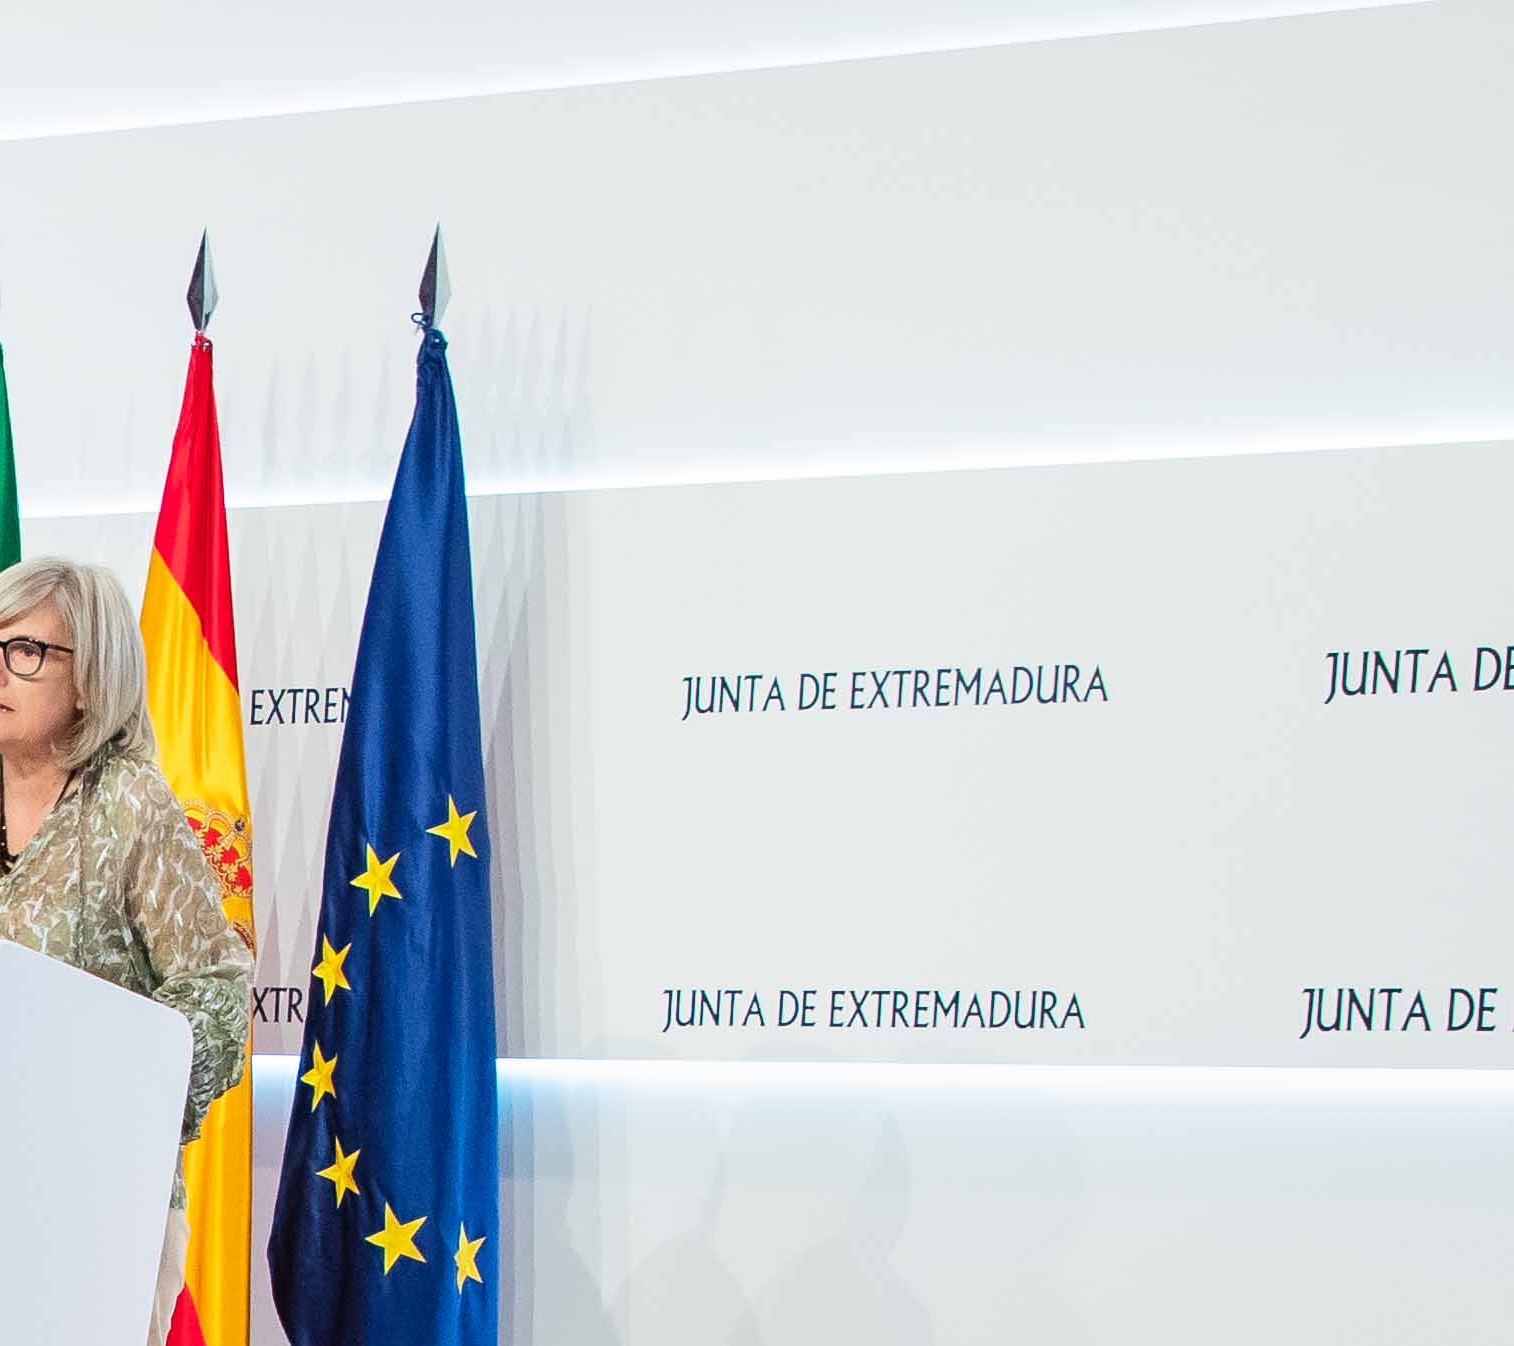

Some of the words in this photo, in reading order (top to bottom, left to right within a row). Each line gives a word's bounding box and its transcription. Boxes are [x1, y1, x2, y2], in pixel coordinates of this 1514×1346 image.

[681, 674, 786, 721] JUNTA
[798, 672, 838, 711] DE
[849, 664, 1109, 710] EXTREMADURA
[1324, 649, 1458, 705] JUNTA
[662, 989, 766, 1033] JUNTA
[777, 990, 818, 1028] DE
[829, 990, 1086, 1030] EXTREMADURA
[1299, 987, 1432, 1040] JUNTA
[1446, 987, 1498, 1032] DE
